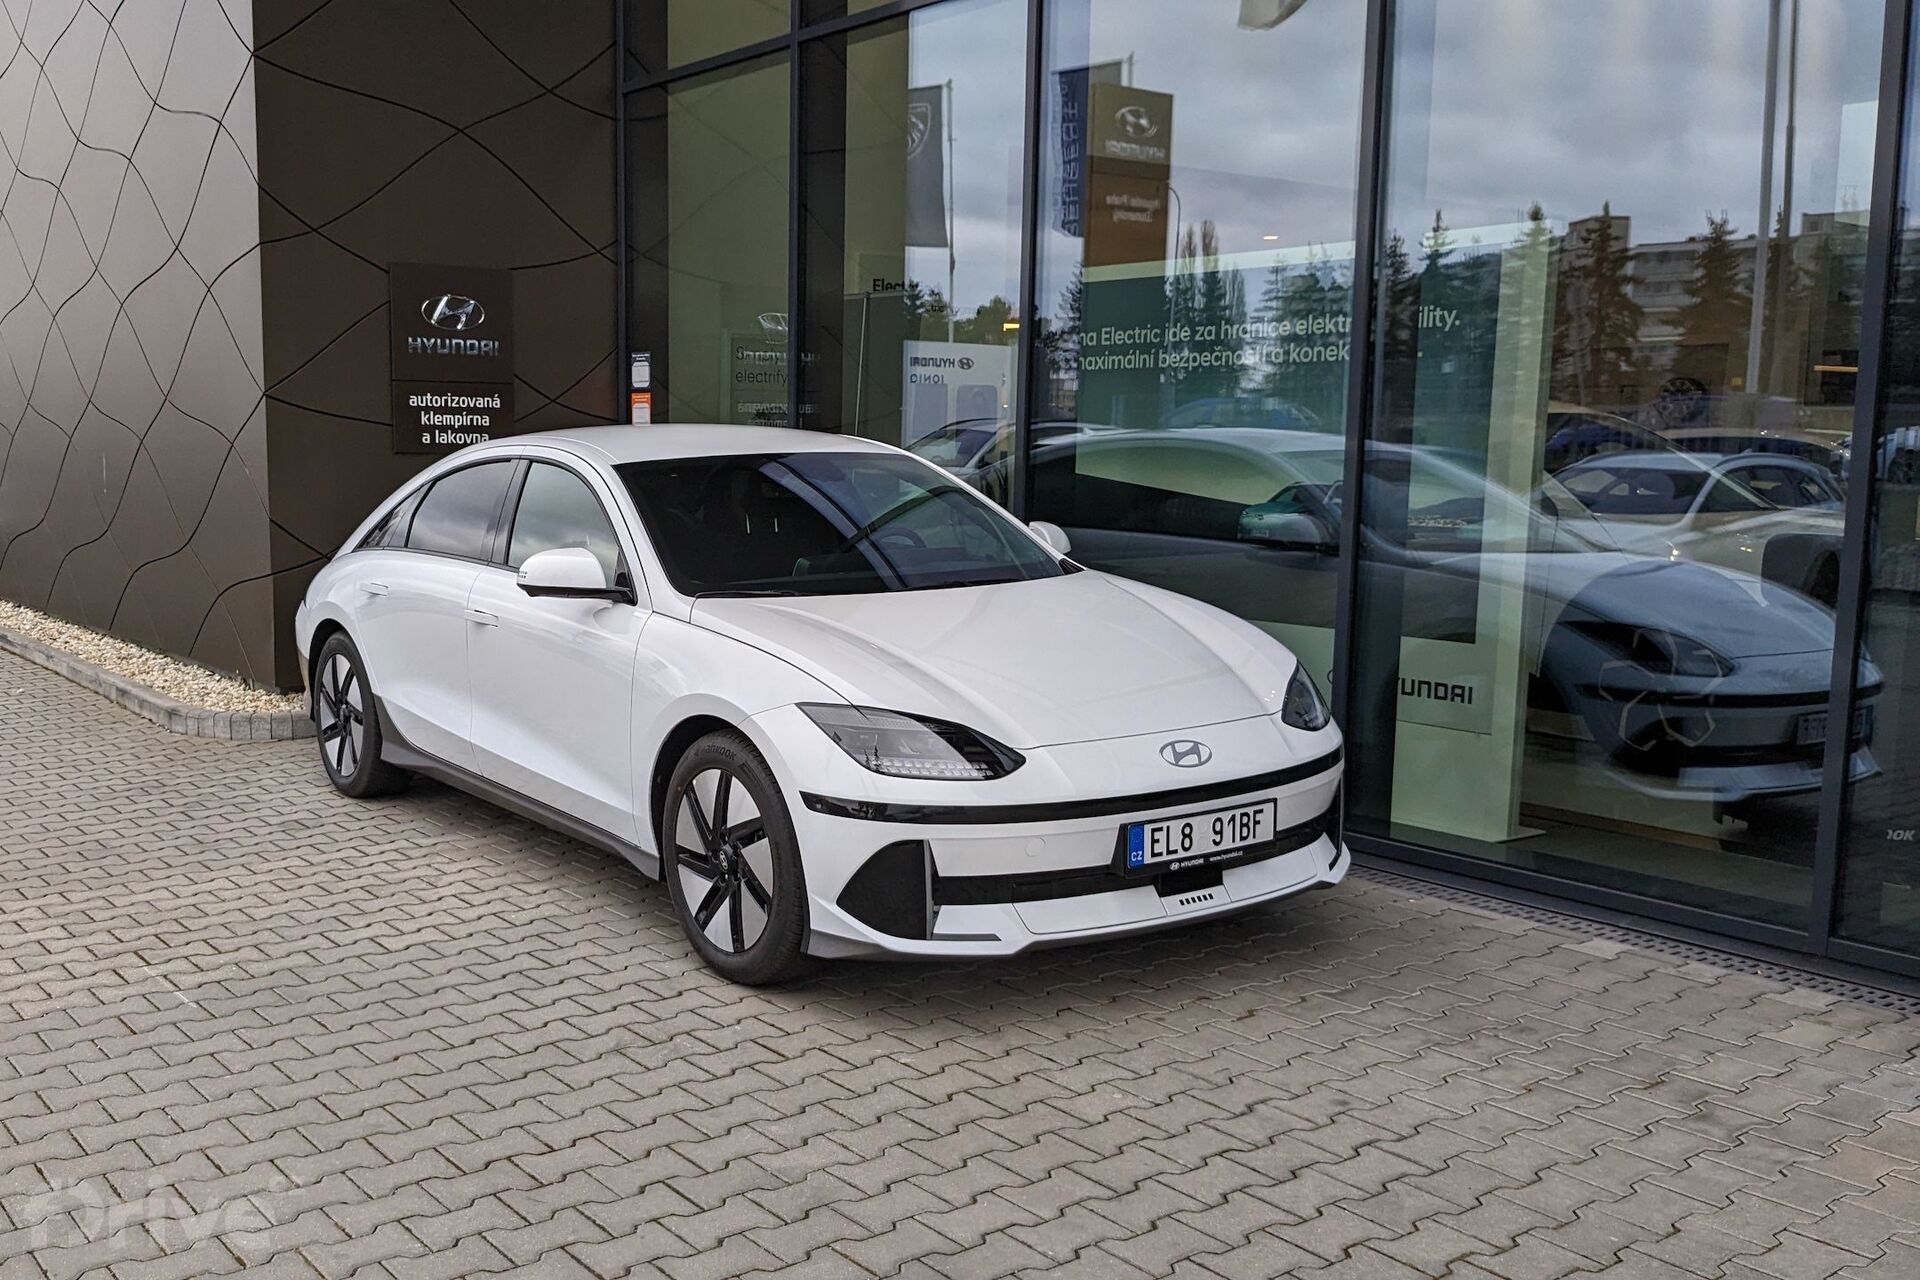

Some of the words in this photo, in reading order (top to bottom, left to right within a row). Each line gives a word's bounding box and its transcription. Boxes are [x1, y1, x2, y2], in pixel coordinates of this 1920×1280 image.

[1101, 324, 1160, 346] Electric
[1163, 322, 1190, 346] jde
[1194, 324, 1215, 341] za
[1220, 317, 1290, 340] hranice
[1418, 304, 1460, 332] ility.
[408, 336, 499, 356] HYUNDAI
[1271, 348, 1284, 363] a
[735, 369, 788, 388] electrify
[408, 392, 501, 408] autorizovaná
[420, 410, 490, 429] klempírna
[421, 431, 431, 444] a
[435, 429, 489, 444] lakovna
[1399, 677, 1473, 705] UNDAI
[1150, 822, 1194, 858] EL8
[1211, 808, 1264, 847] 91BF
[1131, 851, 1143, 862] CZ
[1180, 858, 1204, 868] HYUNDAI
